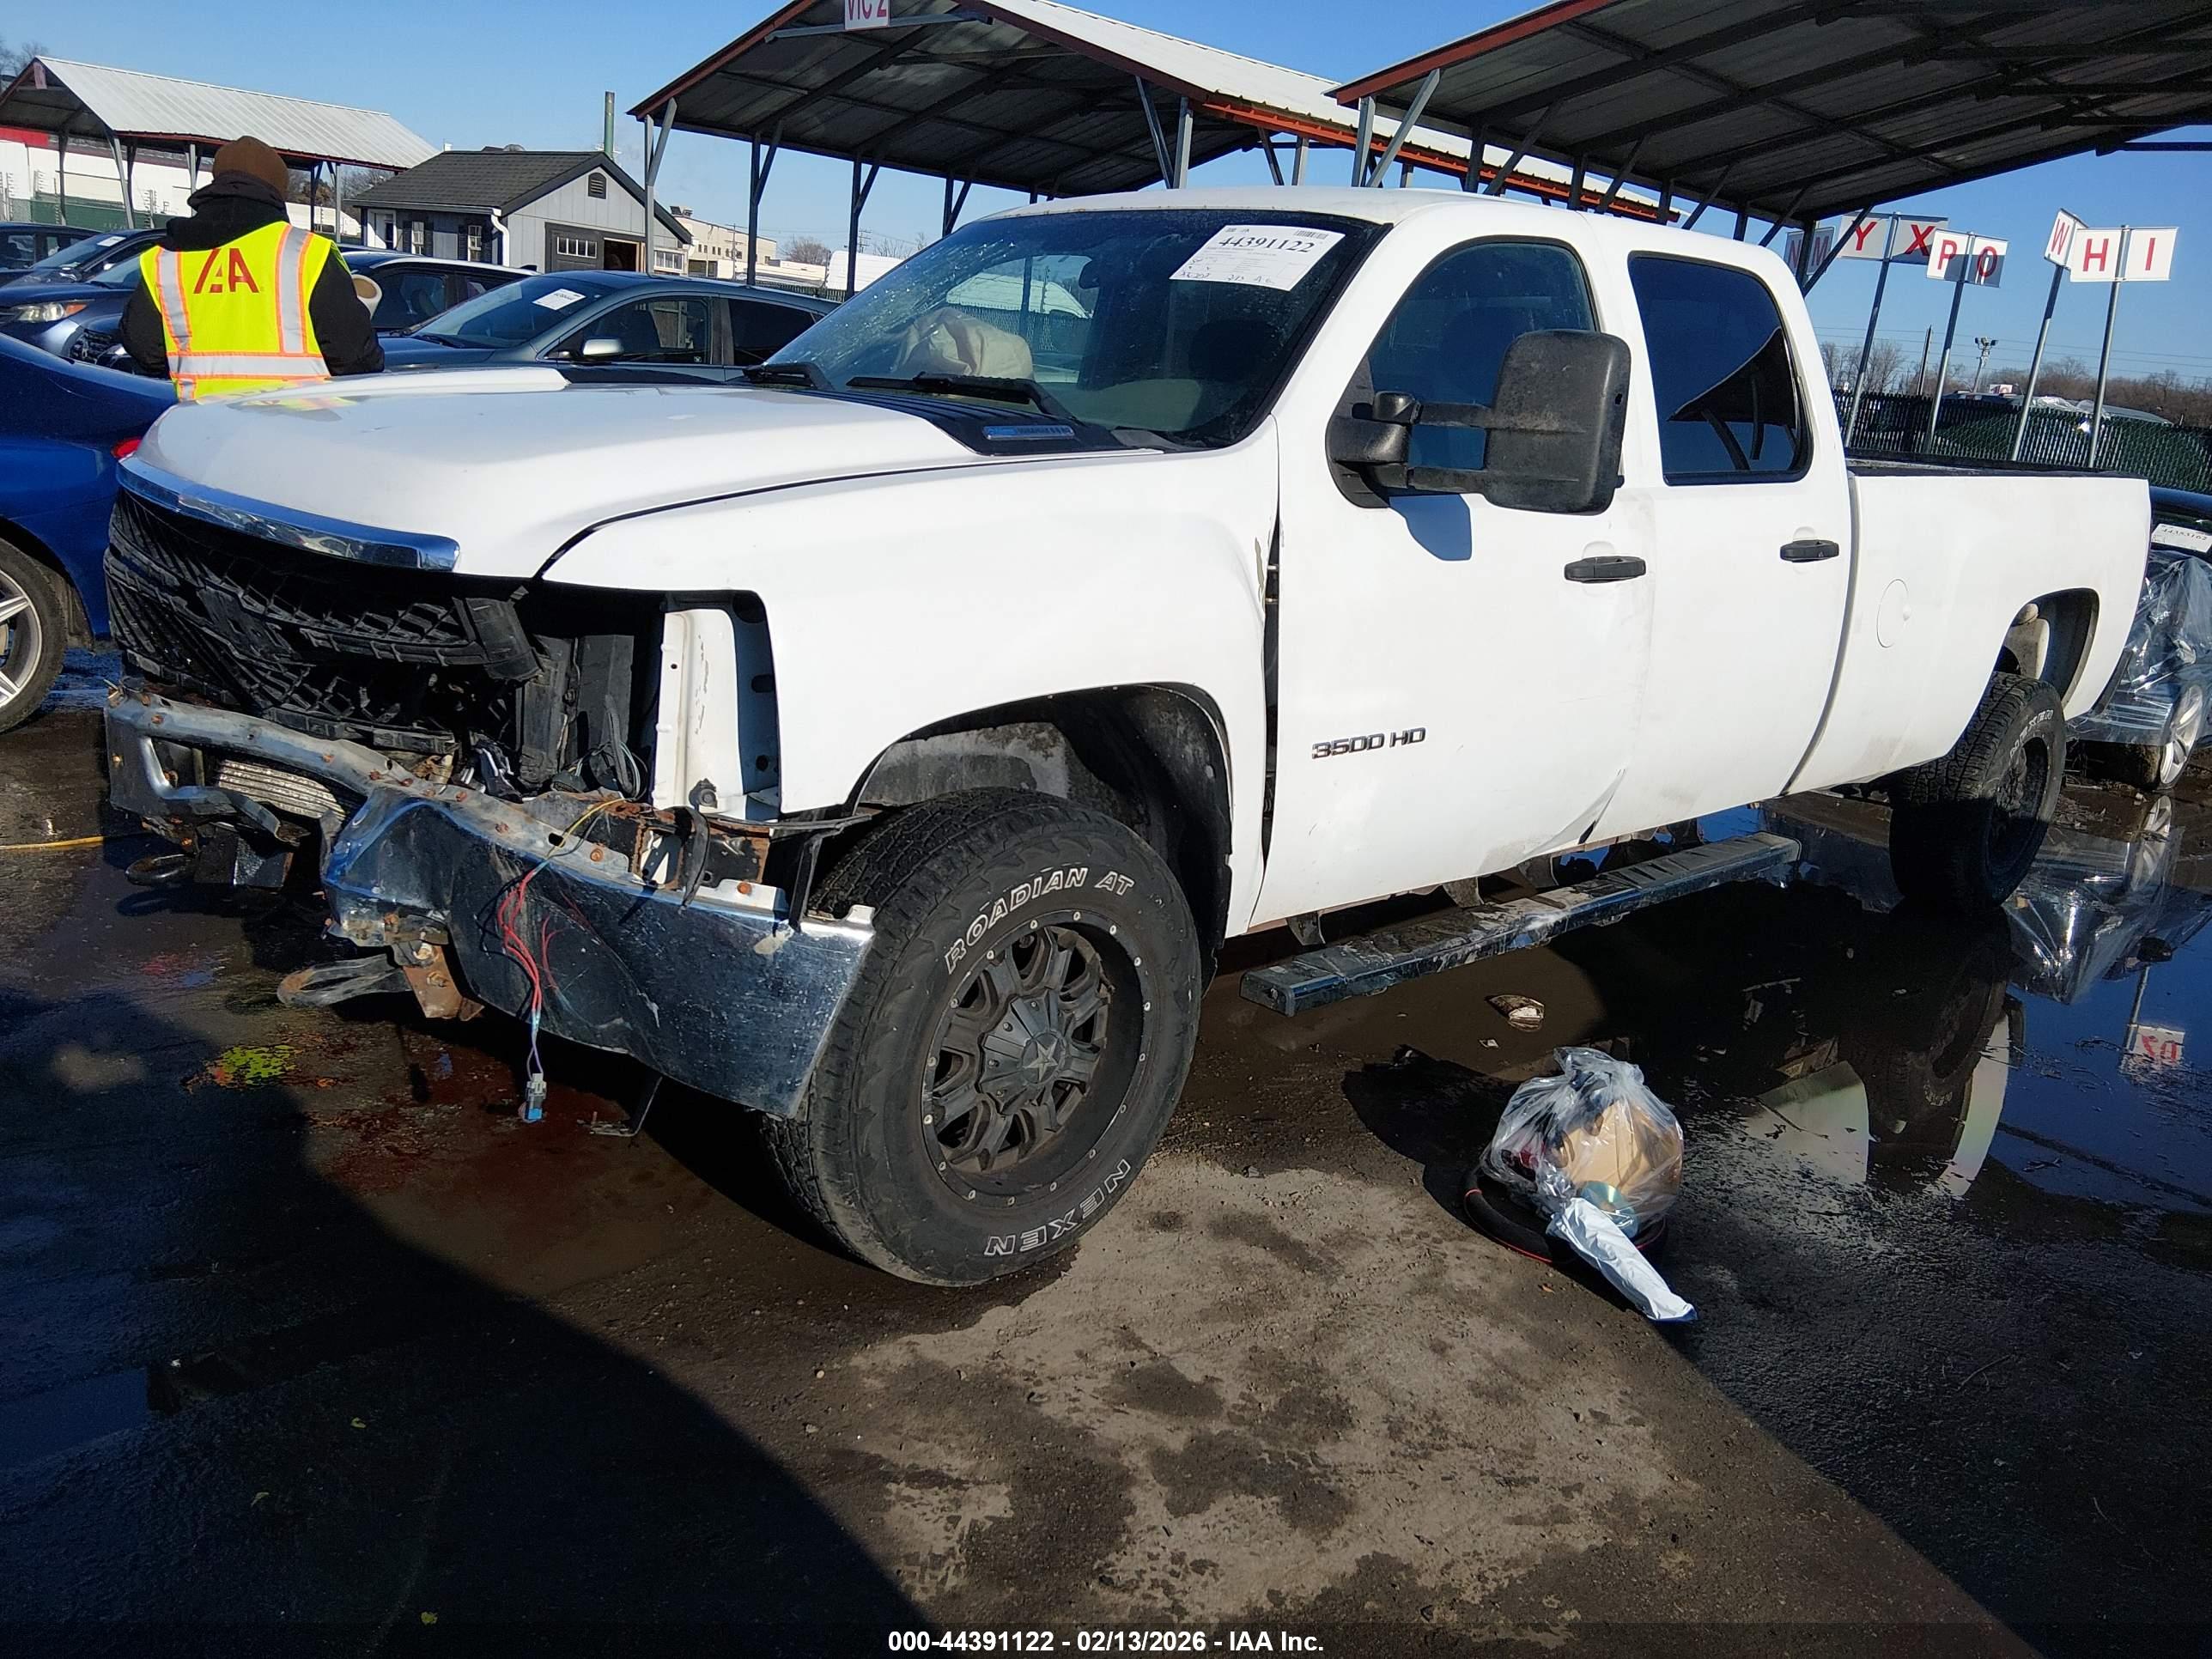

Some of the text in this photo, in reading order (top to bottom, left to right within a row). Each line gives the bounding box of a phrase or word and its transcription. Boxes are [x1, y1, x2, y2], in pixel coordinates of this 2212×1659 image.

[1218, 236, 1315, 253] 44391122
[1812, 235, 1830, 266] M
[1854, 221, 1877, 251] Y
[1904, 224, 1936, 256] X
[2051, 218, 2070, 255] W
[1937, 239, 1958, 270] P
[1977, 246, 1998, 278] O
[2082, 238, 2109, 272] H
[2145, 237, 2156, 271] I
[1311, 726, 1426, 760] 3500 HD
[945, 867, 1135, 975] ROADIAN AT
[983, 1158, 1132, 1256] NEXEN
